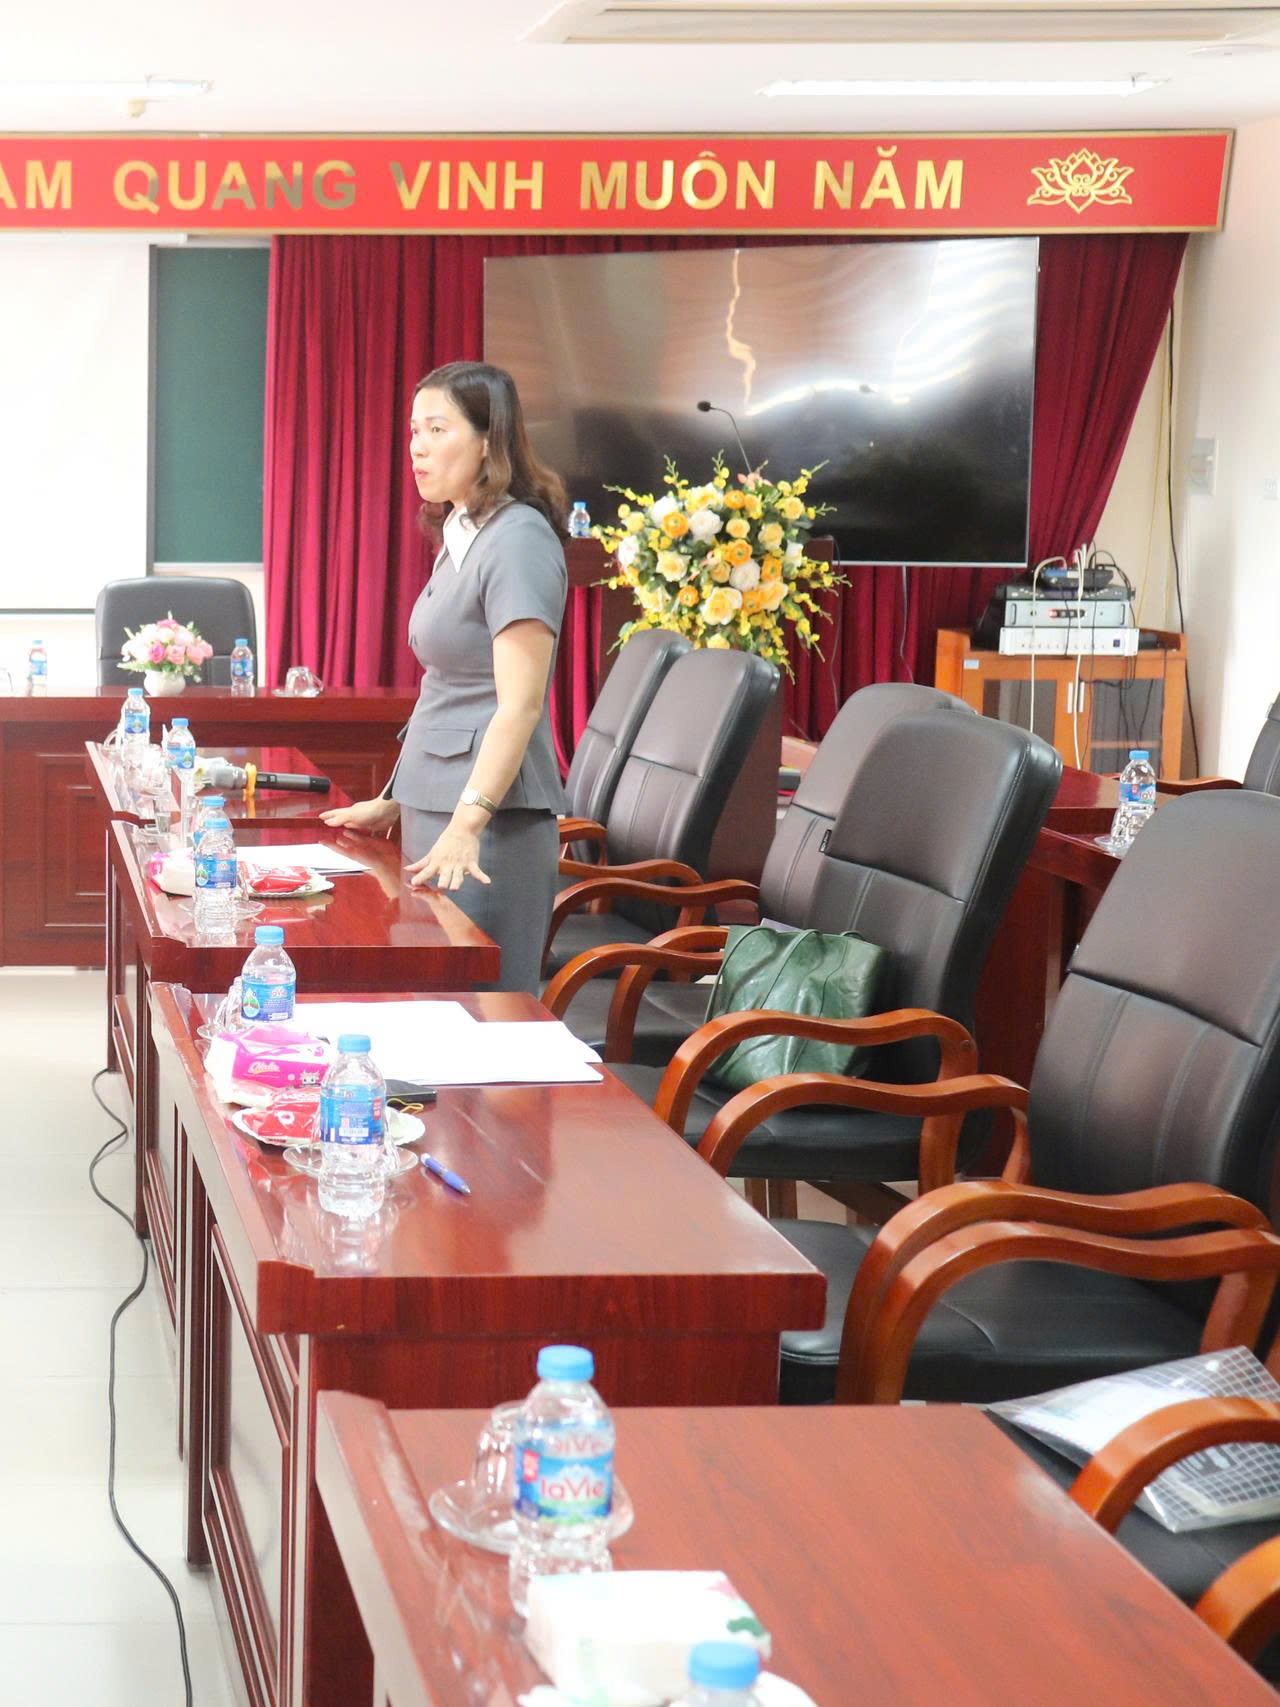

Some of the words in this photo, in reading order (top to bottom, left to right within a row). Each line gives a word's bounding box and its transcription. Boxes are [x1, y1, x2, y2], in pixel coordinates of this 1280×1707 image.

[113, 160, 356, 215] QUANG
[389, 160, 545, 212] VINH
[580, 151, 775, 212] MUÔN
[812, 145, 964, 212] NĂM
